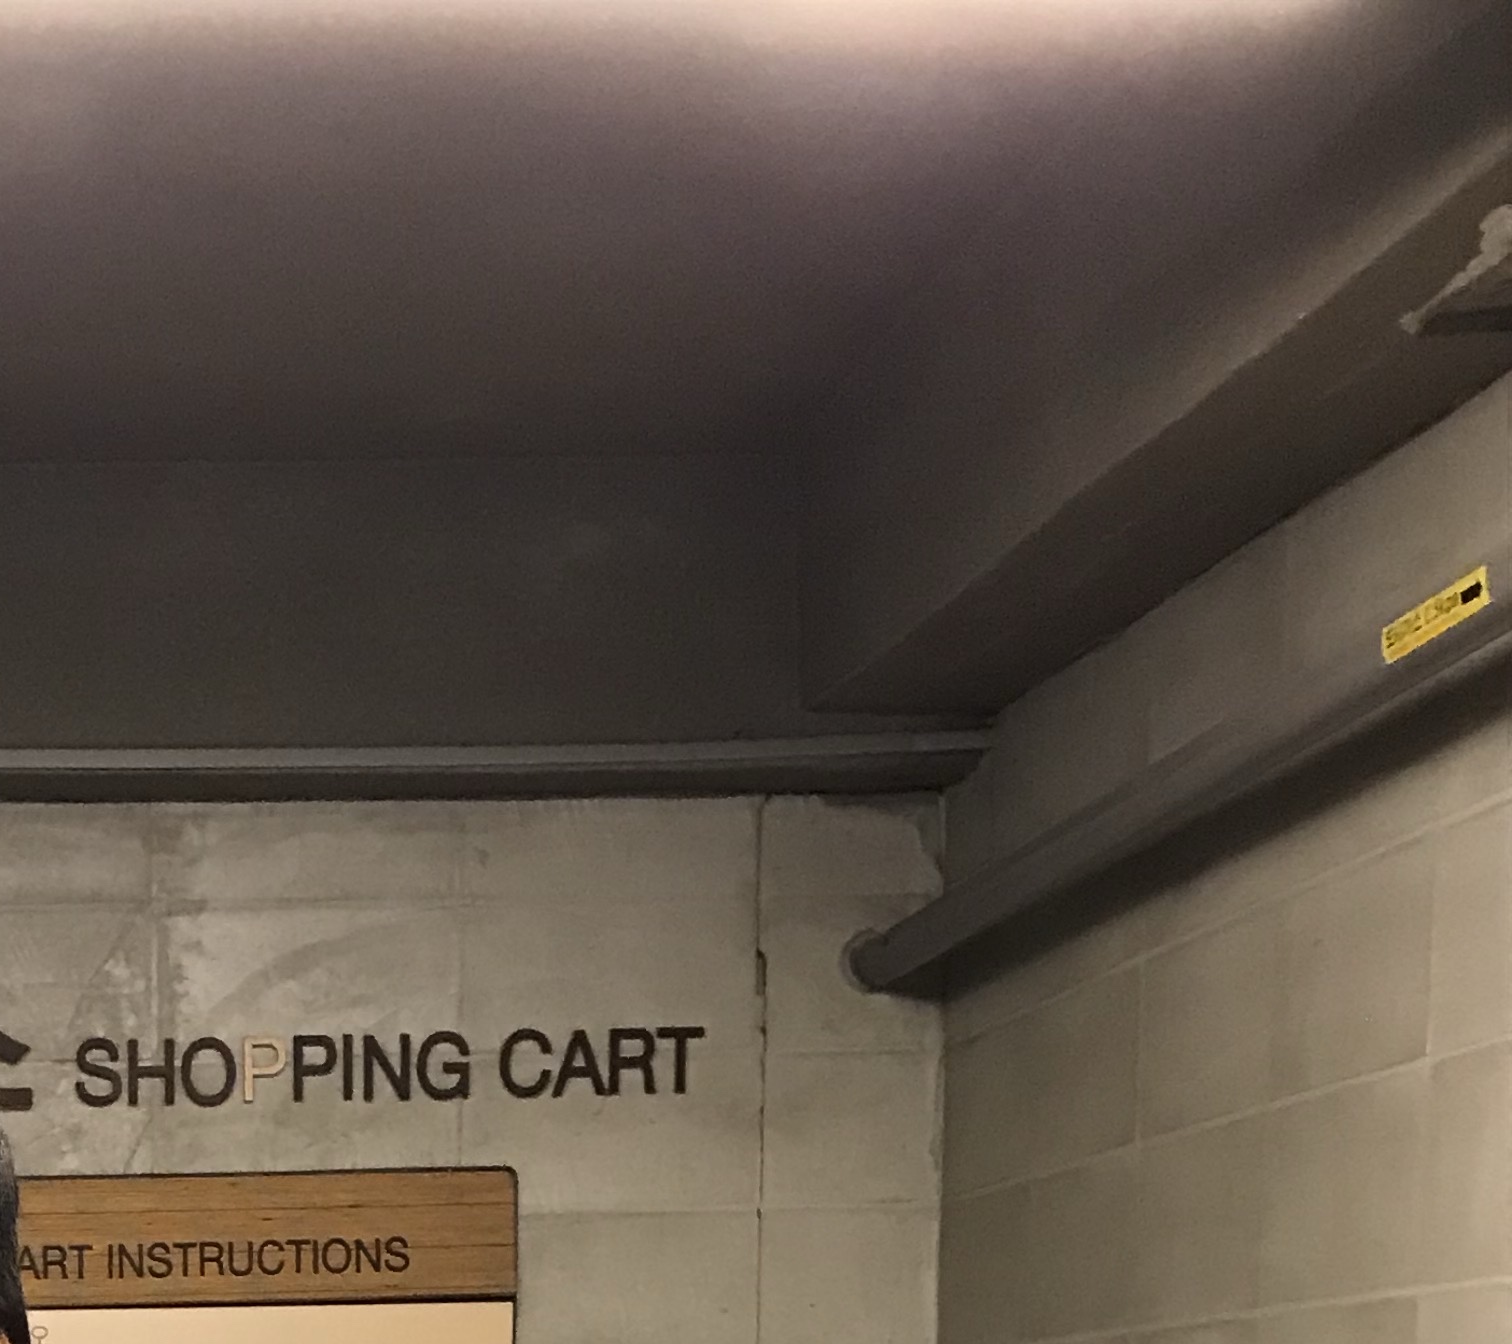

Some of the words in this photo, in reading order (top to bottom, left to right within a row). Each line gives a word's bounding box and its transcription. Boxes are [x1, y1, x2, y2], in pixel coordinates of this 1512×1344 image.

[74, 1031, 473, 1108] SHOPPING
[498, 1025, 706, 1099] CART
[18, 1245, 94, 1280] ART
[106, 1235, 411, 1279] INSTRUCTIONS
